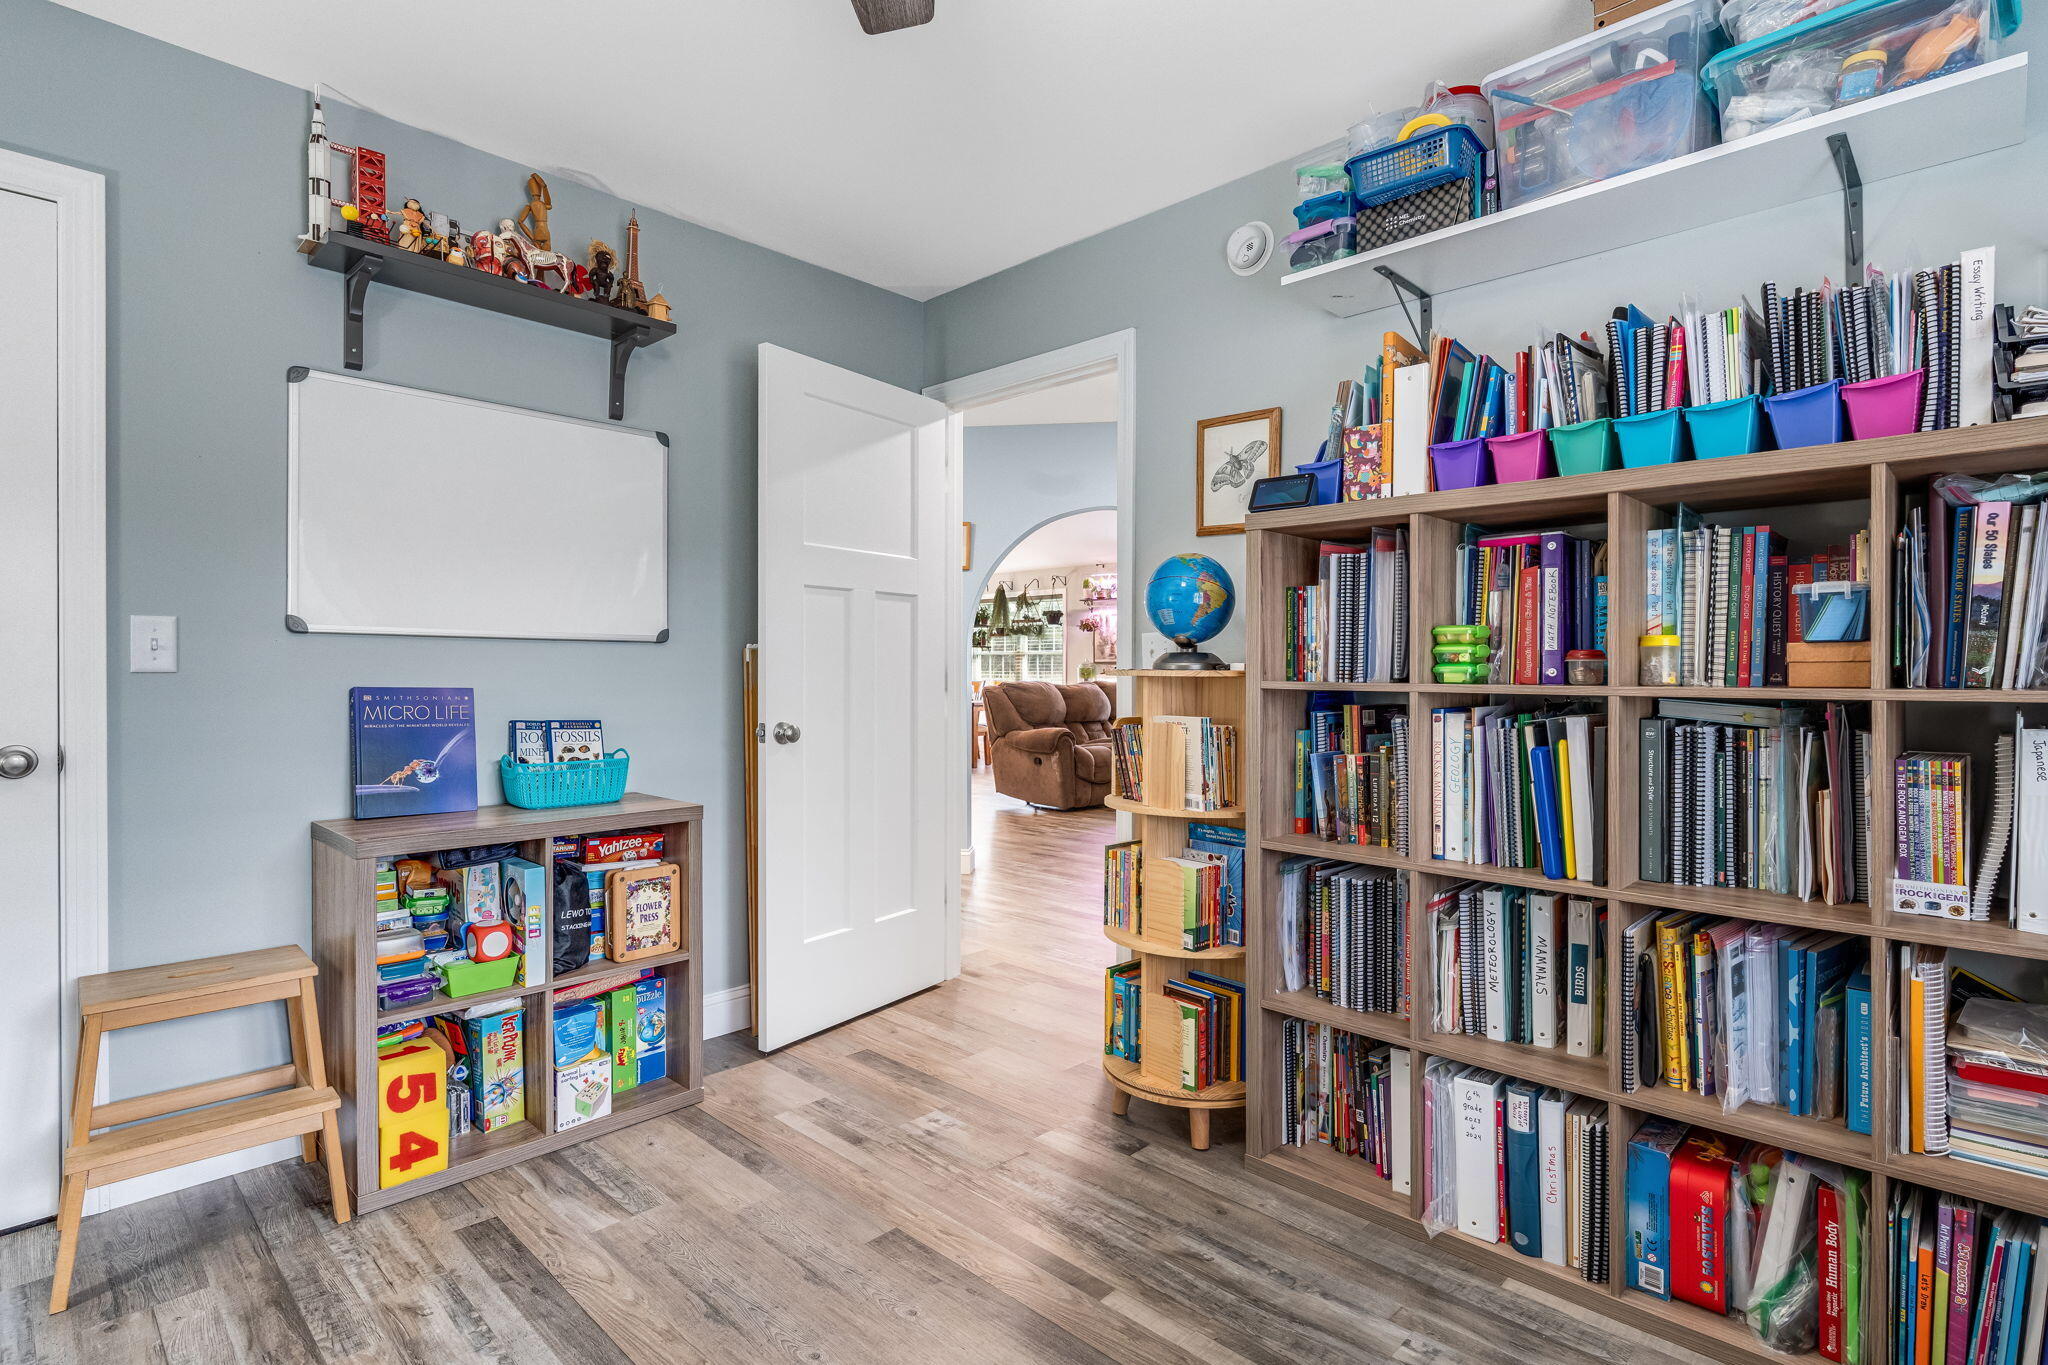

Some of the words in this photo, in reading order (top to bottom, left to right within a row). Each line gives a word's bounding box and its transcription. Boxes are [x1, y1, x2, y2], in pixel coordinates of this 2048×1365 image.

[1968, 259, 1984, 285] Essay
[1970, 286, 1987, 321] Writing
[1959, 513, 1969, 529] THE
[1986, 512, 2000, 526] Our
[1651, 537, 1659, 547] Our
[1666, 536, 1675, 546] Our
[1957, 531, 1968, 556] GREAT
[1985, 530, 1999, 542] 50
[1758, 535, 1766, 556] HISTORY
[1744, 557, 1752, 573] QUEST
[1757, 556, 1765, 574] QUEST
[1982, 543, 1997, 569] States
[1955, 558, 1965, 580] BOOK
[1650, 582, 1659, 596] Story
[1665, 581, 1675, 595] Story
[1743, 585, 1751, 601] STUDY
[1756, 584, 1764, 600] STUDY
[1773, 571, 1783, 608] HISTORY
[1955, 582, 1964, 591] OF
[1651, 601, 1659, 611] Part
[1666, 600, 1675, 610] Part
[1730, 602, 1738, 619] GUIDE
[1952, 594, 1962, 623] STATES
[1772, 609, 1783, 638] QUEST
[1547, 624, 1556, 650] MATH
[363, 705, 430, 721] MICRO
[435, 705, 470, 720] LIFE
[554, 731, 601, 743] FOSSILS
[1433, 741, 1441, 771] ROCKS
[2031, 740, 2047, 783] Japanese
[1449, 737, 1463, 794] GEOLOGY
[1897, 774, 1906, 788] THE
[1433, 780, 1441, 824] MINERALS
[1647, 786, 1655, 801] Style
[1897, 789, 1907, 809] ROCK
[1372, 815, 1378, 823] 12
[1898, 810, 1907, 825] AND
[1898, 826, 1907, 841] GEM
[598, 837, 643, 858] Yahtzee
[1899, 843, 1908, 858] BOX
[1900, 889, 1932, 899] ROCK
[1937, 893, 1965, 903] GEM
[561, 908, 584, 919] LEWO
[636, 900, 663, 913] FLOWER
[528, 905, 542, 939] LIFE
[640, 912, 659, 924] PRESS
[1485, 909, 1499, 993] METEOROLOGY
[1663, 935, 1674, 958] 365
[1535, 935, 1548, 995] MAMMALS
[1574, 965, 1585, 997] BIRDS
[1663, 960, 1675, 1000] Science
[636, 989, 662, 1004] puzzle
[1664, 1002, 1676, 1041] Activities
[1860, 1037, 1868, 1080] Architect's
[561, 1069, 578, 1079] Animal
[386, 1072, 437, 1114] 5
[1860, 1081, 1868, 1108] Future
[1463, 1103, 1482, 1113] grade
[1464, 1115, 1481, 1124] 2023
[1465, 1131, 1482, 1142] 2024
[389, 1131, 439, 1173] 4
[1545, 1146, 1558, 1204] Christmas
[1701, 1205, 1715, 1260] STATES
[1824, 1220, 1840, 1248] Body
[1940, 1223, 1950, 1235] Art
[1939, 1235, 1950, 1258] Projects
[1701, 1260, 1715, 1277] 50
[1825, 1250, 1838, 1289] Human
[1956, 1259, 1969, 1296] PROJECTS
[1920, 1273, 1931, 1291] Let's
[1831, 1292, 1839, 1318] Magnetic
[1920, 1294, 1929, 1310] Draw
[1954, 1296, 1968, 1306] 2
